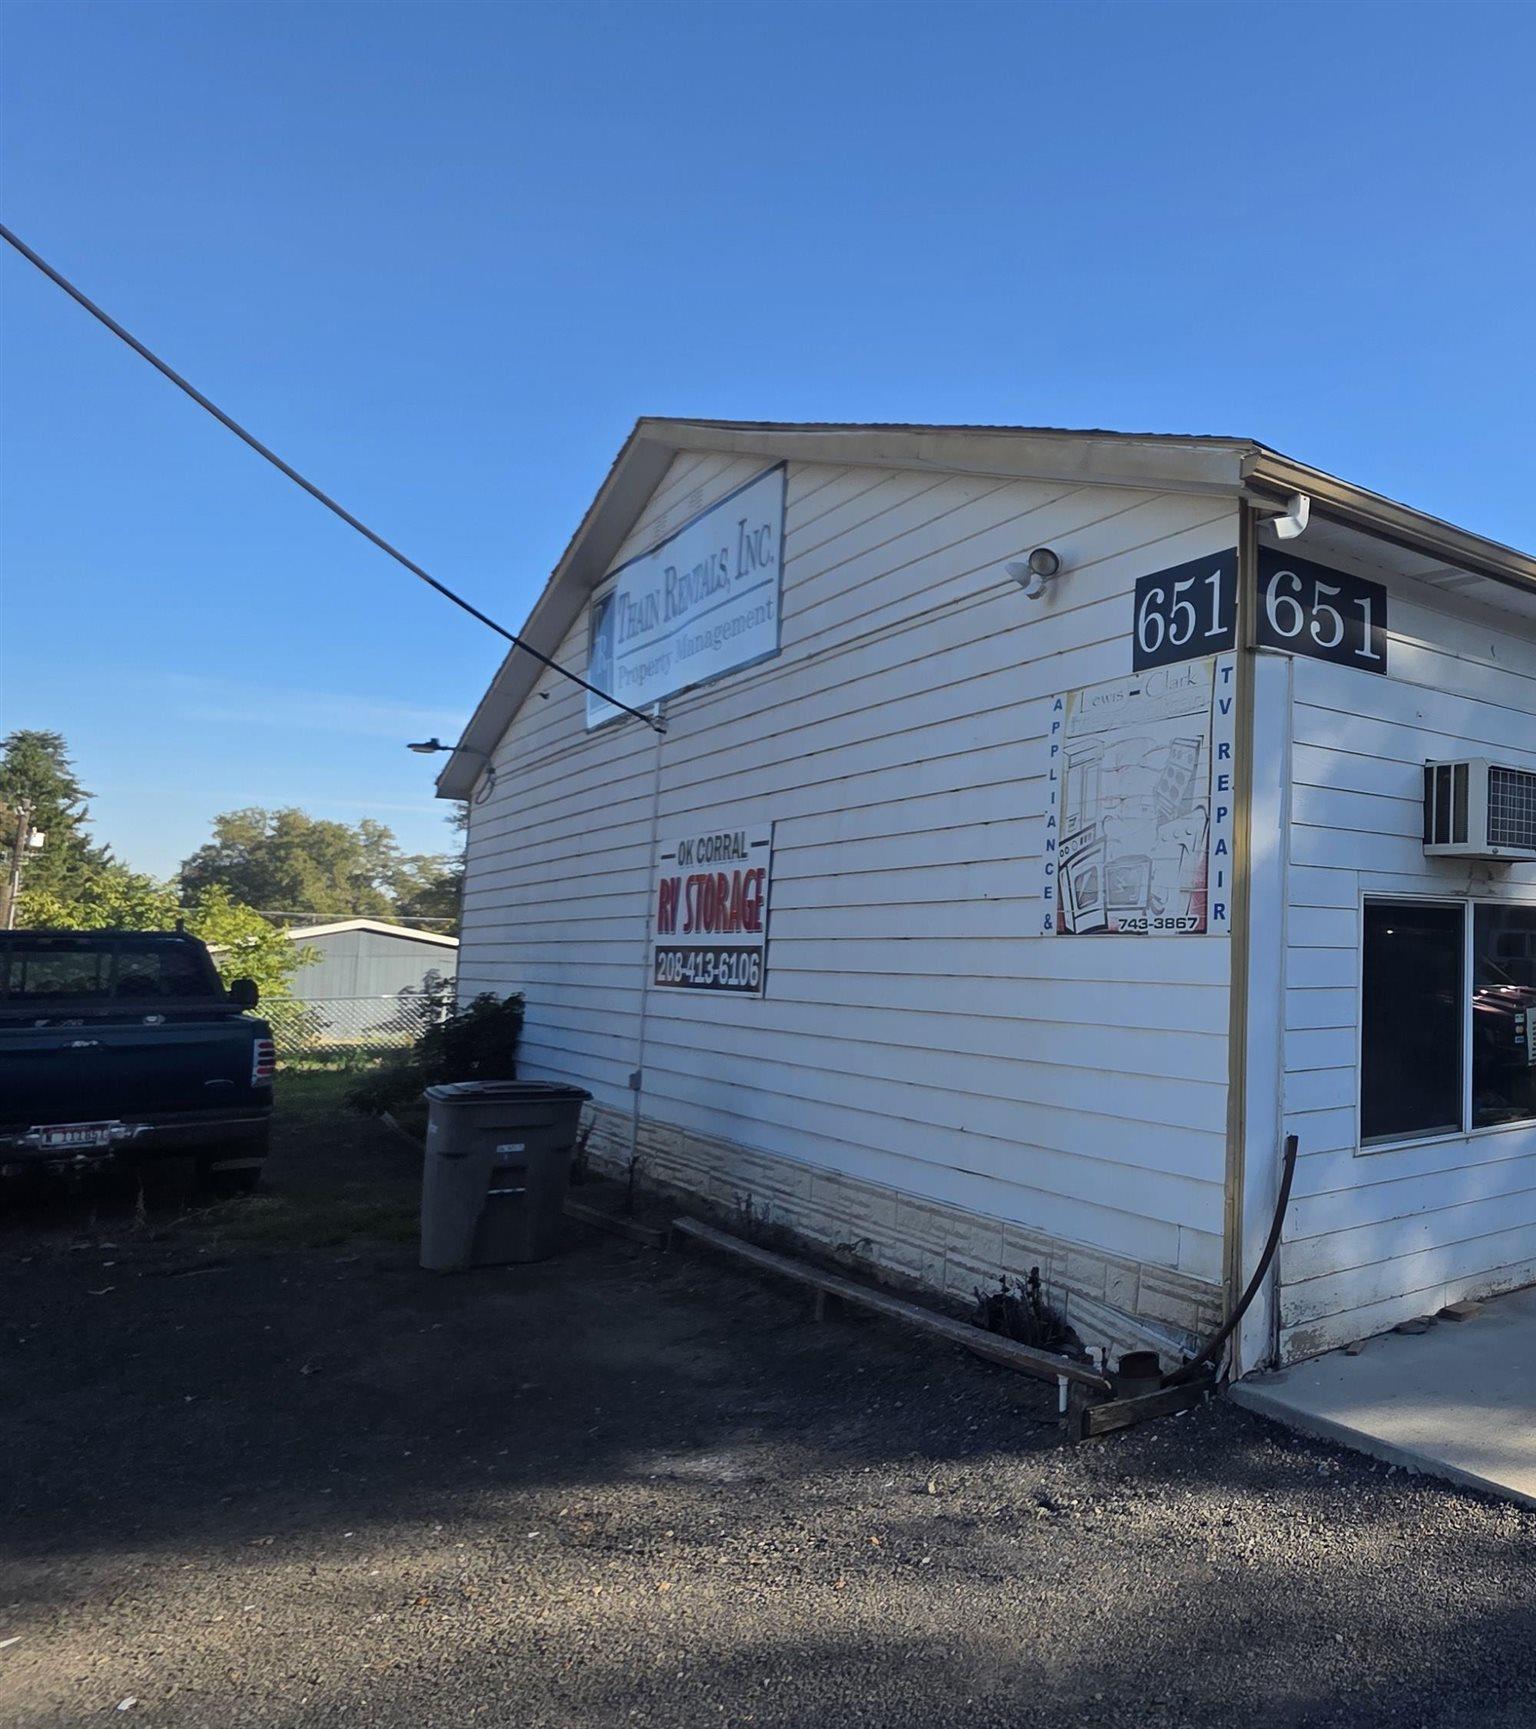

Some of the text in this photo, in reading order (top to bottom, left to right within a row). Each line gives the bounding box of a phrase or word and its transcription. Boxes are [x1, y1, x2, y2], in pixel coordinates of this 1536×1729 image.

[735, 518, 774, 580] INC.
[618, 652, 672, 689] Property
[675, 598, 775, 663] Management
[1138, 569, 1229, 653] 651
[1265, 570, 1381, 660] 651
[1080, 690, 1124, 713] Lewis
[1145, 665, 1198, 697] Clark
[1044, 698, 1063, 900] APPLIANCE
[1213, 742, 1231, 920] REPAIR
[677, 831, 748, 866] OK CORRAL
[658, 868, 766, 935] RV STORAGE
[1118, 917, 1199, 930] 743-3867
[657, 952, 760, 986] 208-413-6106
